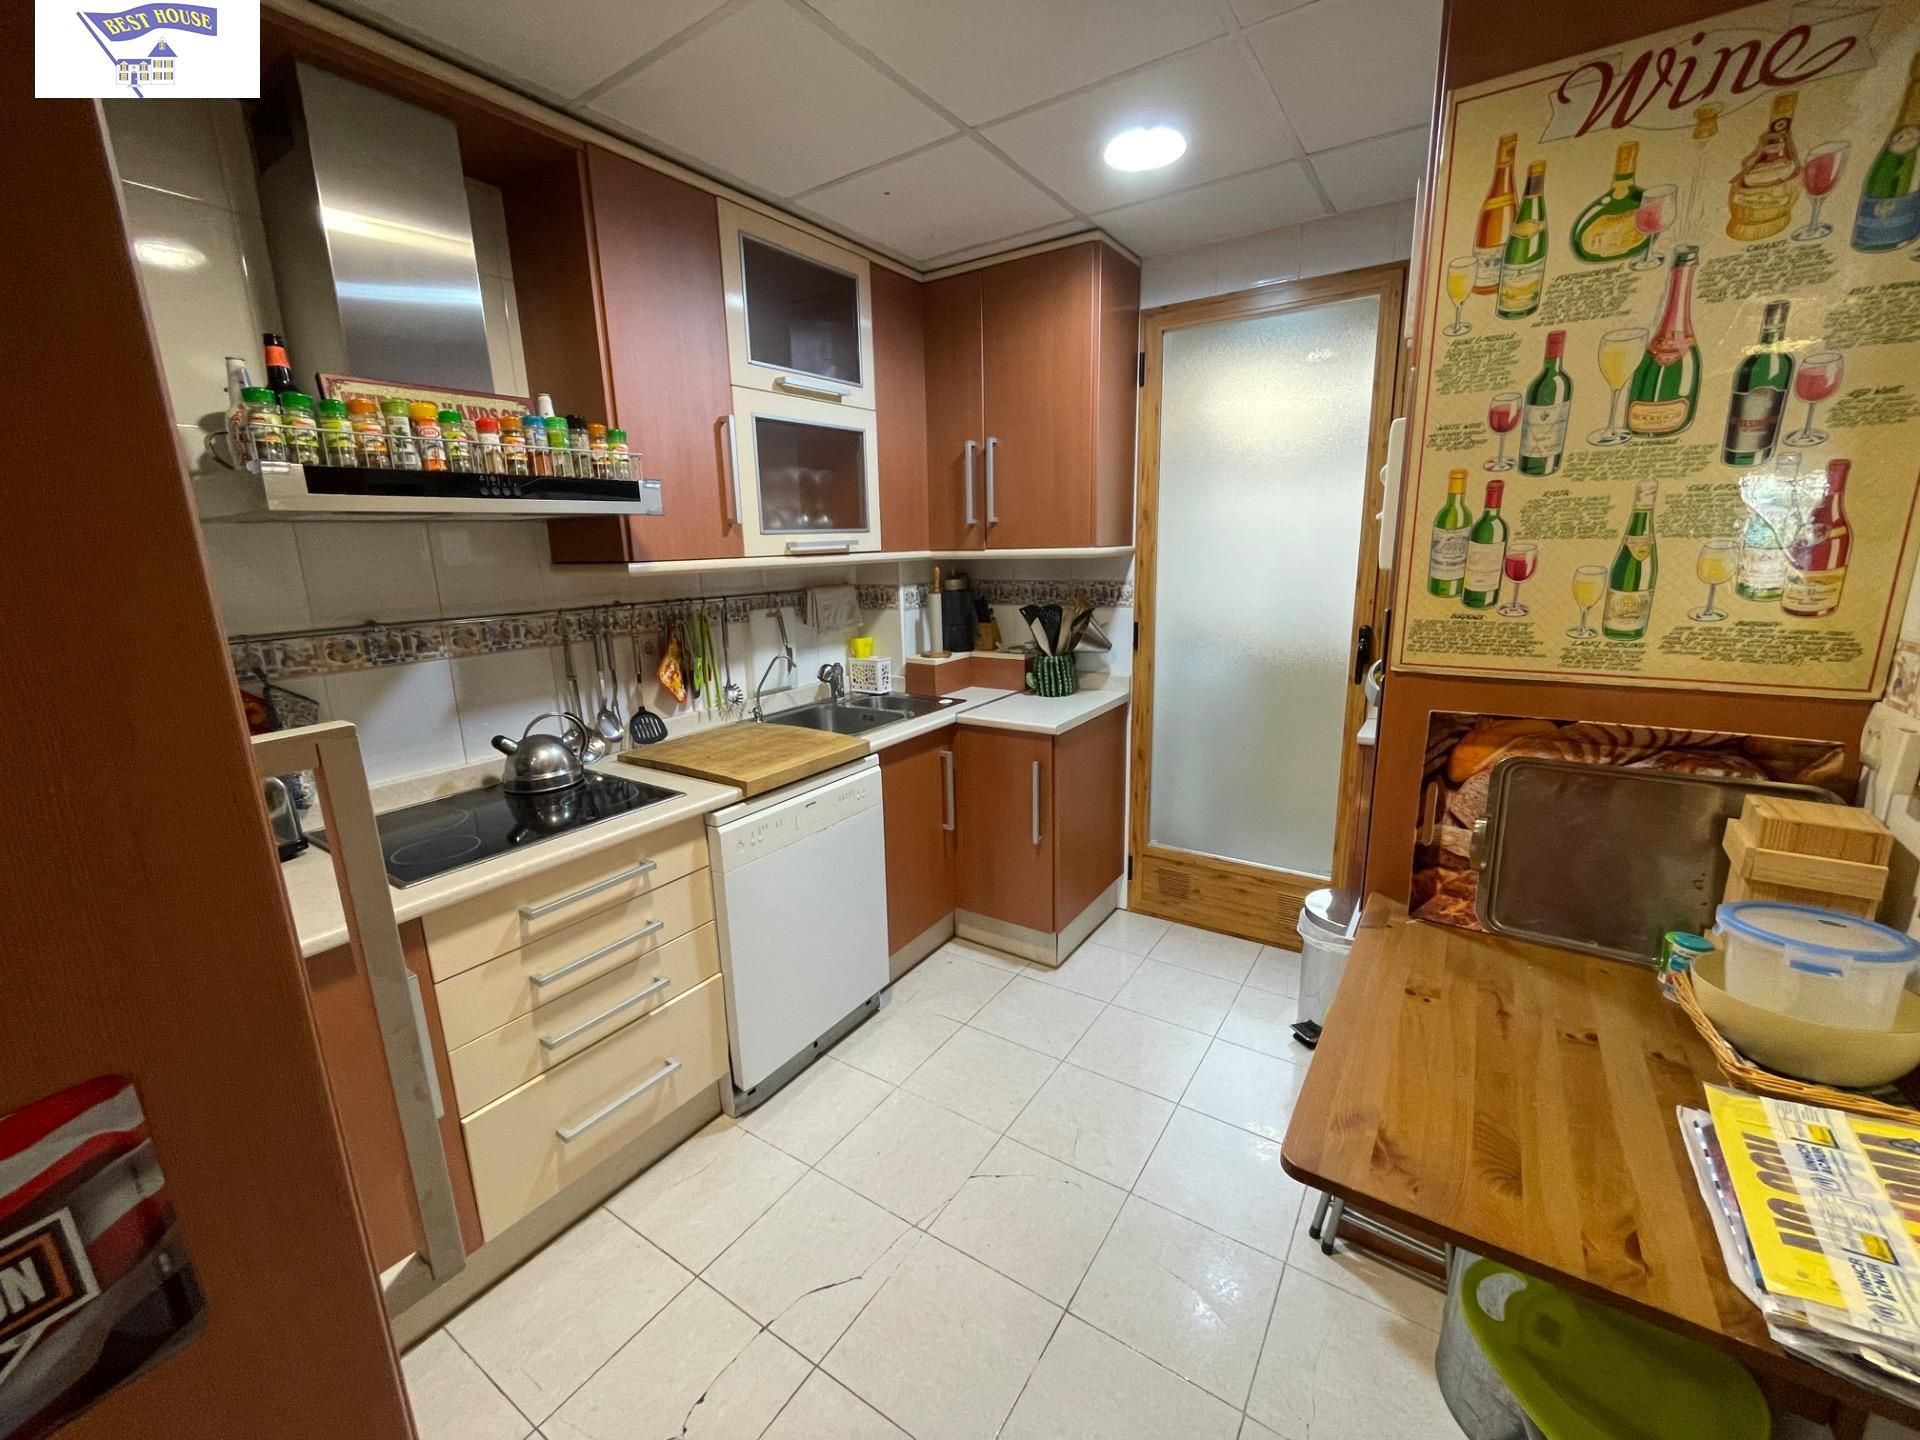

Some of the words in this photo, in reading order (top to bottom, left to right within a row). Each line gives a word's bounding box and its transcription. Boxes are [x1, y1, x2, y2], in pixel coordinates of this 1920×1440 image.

[1557, 25, 1857, 138] Wine
[1848, 1257, 1878, 1297] UNHCR
[1866, 1262, 1897, 1302] ACNUR
